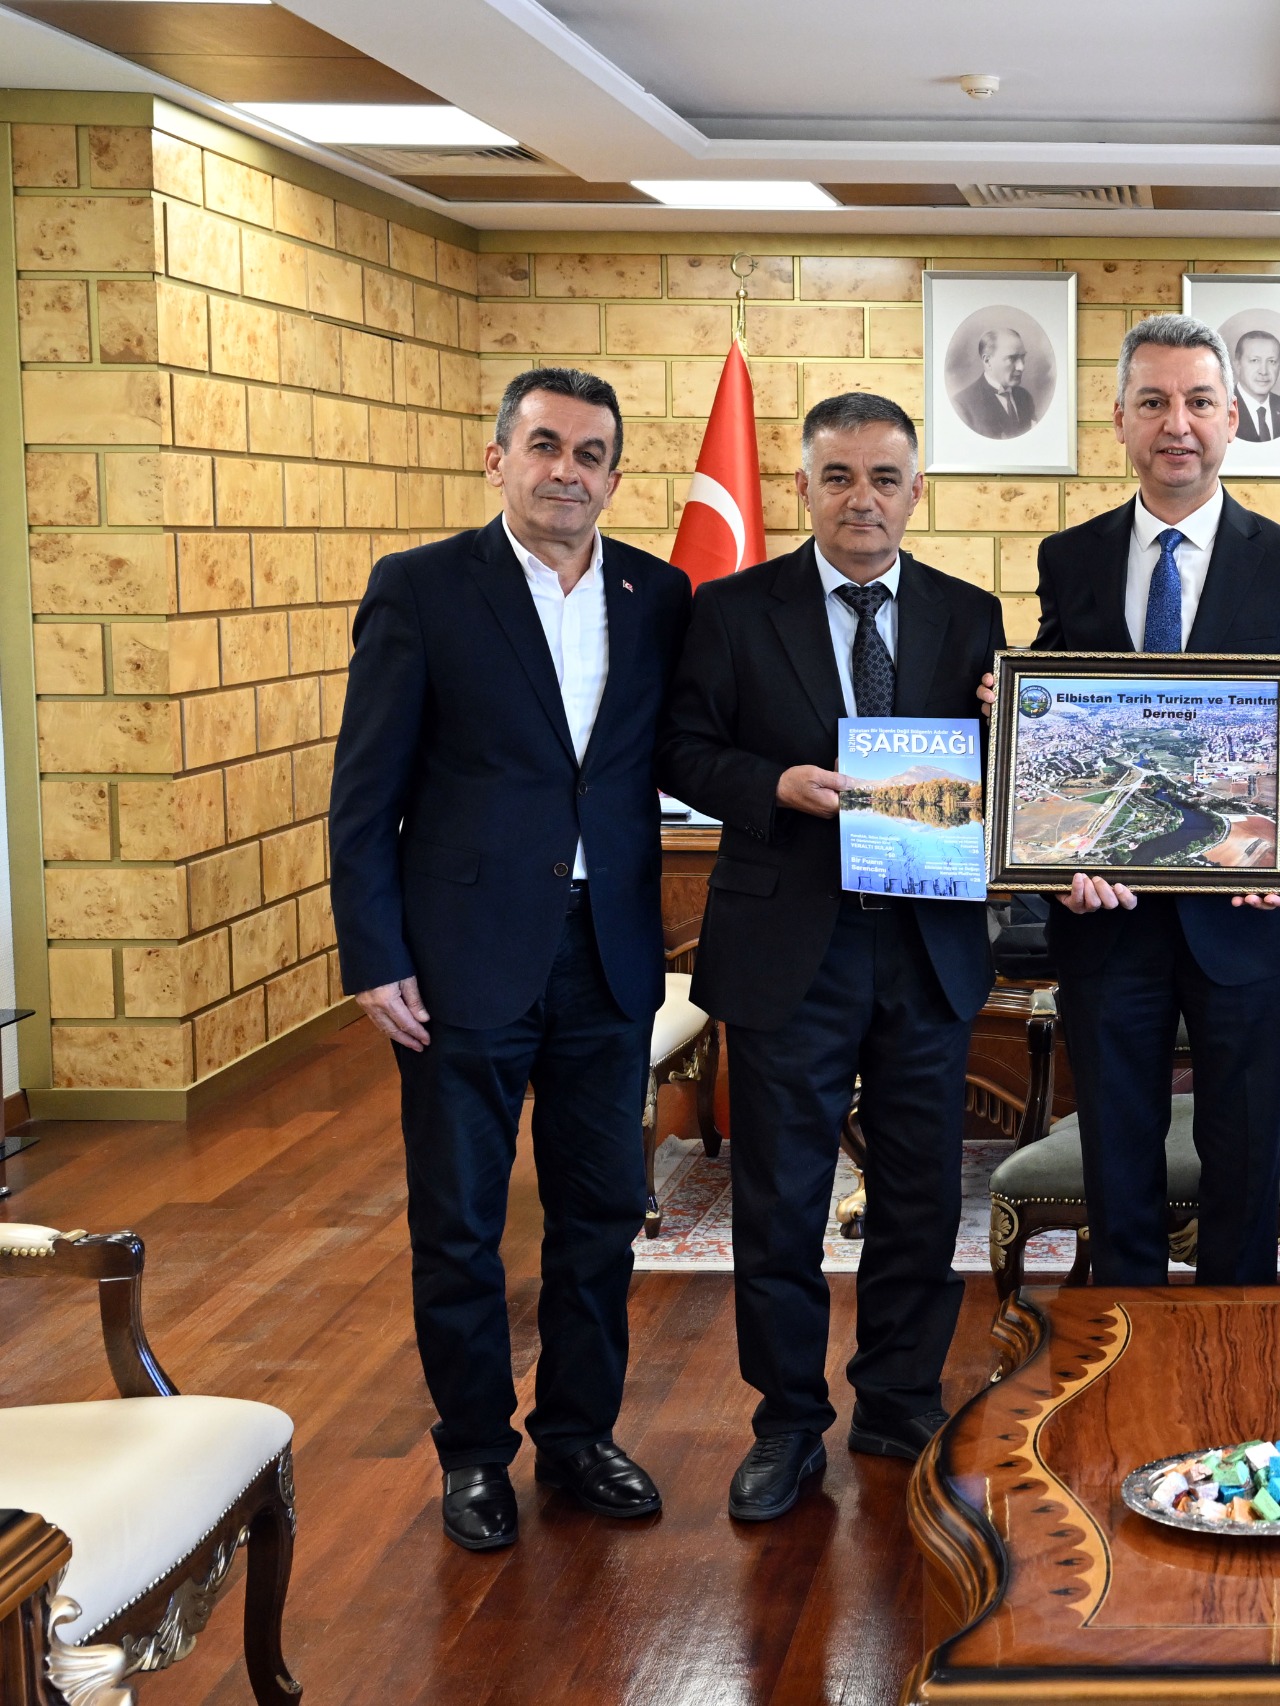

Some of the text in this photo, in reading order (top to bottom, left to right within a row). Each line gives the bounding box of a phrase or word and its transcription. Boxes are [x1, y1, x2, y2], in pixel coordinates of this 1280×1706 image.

[1056, 693, 1112, 703] Elbistan
[1117, 693, 1152, 704] Tarih
[1157, 694, 1203, 705] Turizm
[1208, 697, 1223, 705] ve
[1143, 708, 1197, 720] Derneği
[856, 730, 975, 758] ŞARDAĞI
